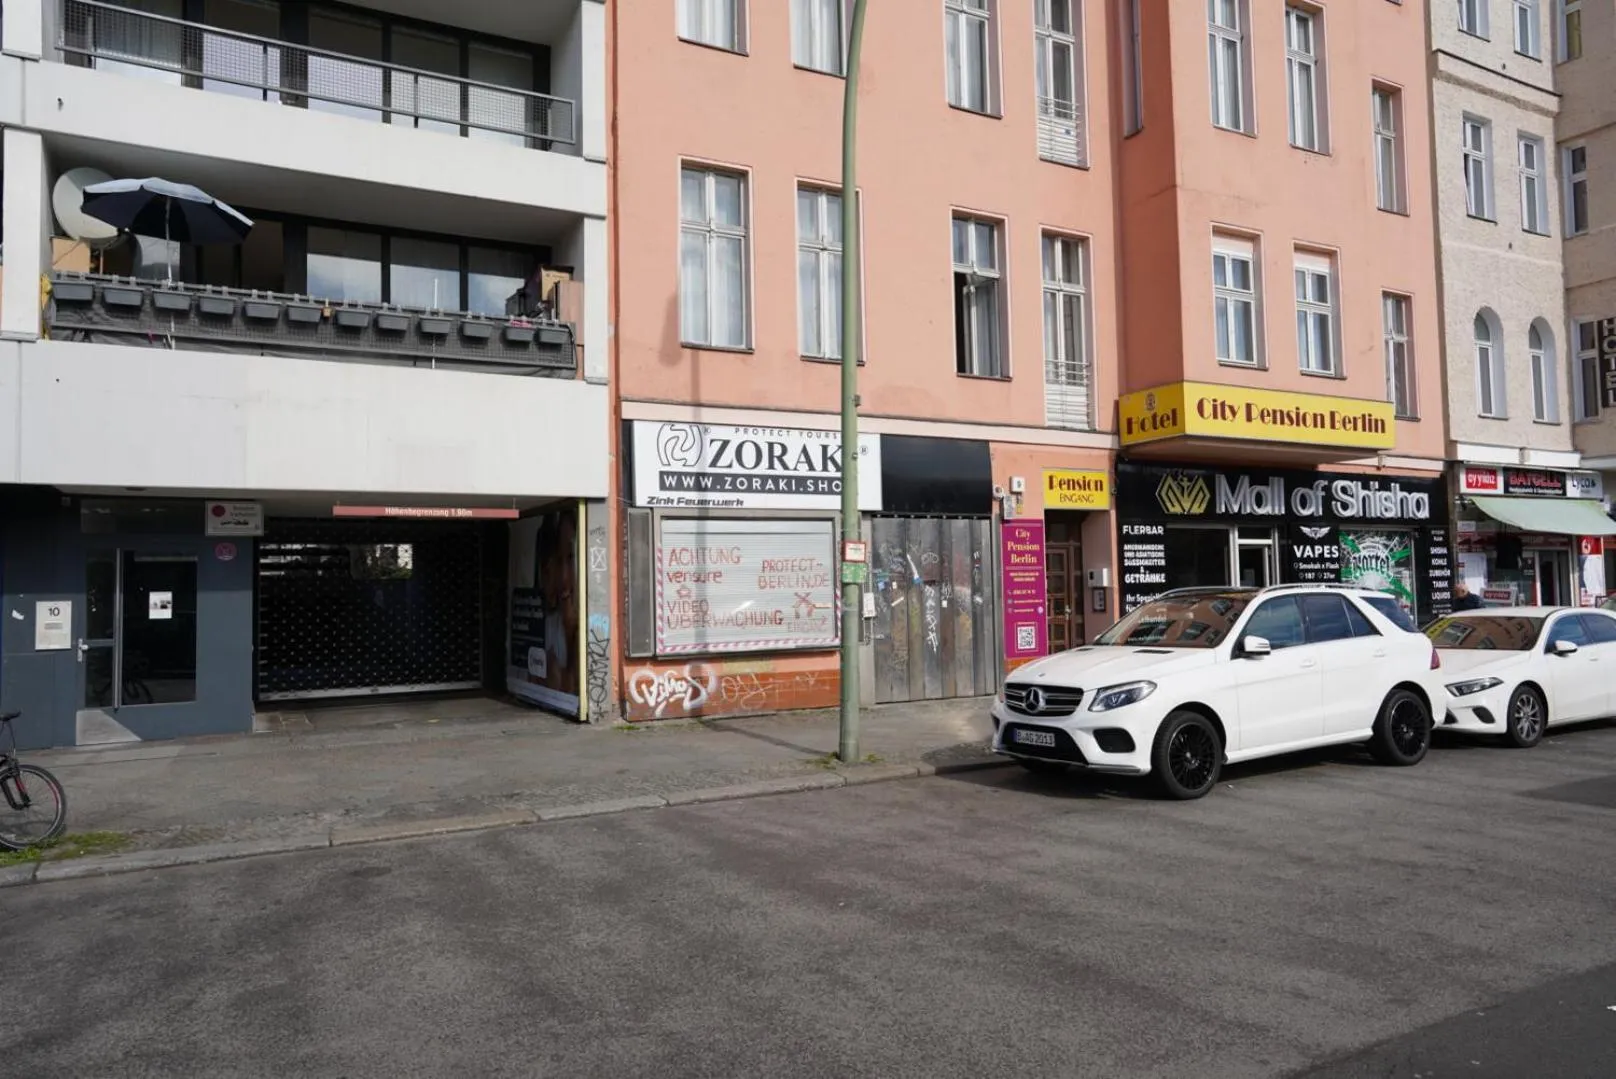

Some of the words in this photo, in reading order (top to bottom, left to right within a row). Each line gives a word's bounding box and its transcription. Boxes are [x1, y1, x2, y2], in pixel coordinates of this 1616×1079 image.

[1126, 408, 1178, 435] Hotel
[1197, 397, 1240, 422] City
[1245, 402, 1326, 429] Pension
[1329, 410, 1386, 434] Berlin
[734, 427, 791, 437] PROTECT
[799, 431, 838, 440] YOURS
[708, 438, 842, 473] ZORAK
[663, 474, 842, 493] WWW.ZORAKI.SHO
[1048, 475, 1104, 492] Pension
[646, 496, 675, 506] Zink
[676, 497, 745, 507] Feuerwerk
[1215, 474, 1286, 515] Mall
[1291, 479, 1328, 517] of
[1331, 479, 1430, 519] Shisha
[1015, 528, 1031, 541] City
[1122, 525, 1165, 535] FLERBAR
[1007, 541, 1040, 551] Pension
[1293, 544, 1339, 559] VAPES
[668, 547, 741, 567] ACHTUNG
[1011, 553, 1038, 563] Berlin
[1125, 571, 1166, 583] GETRÄNKE
[48, 606, 60, 617] 10
[667, 600, 710, 616] VIDEO
